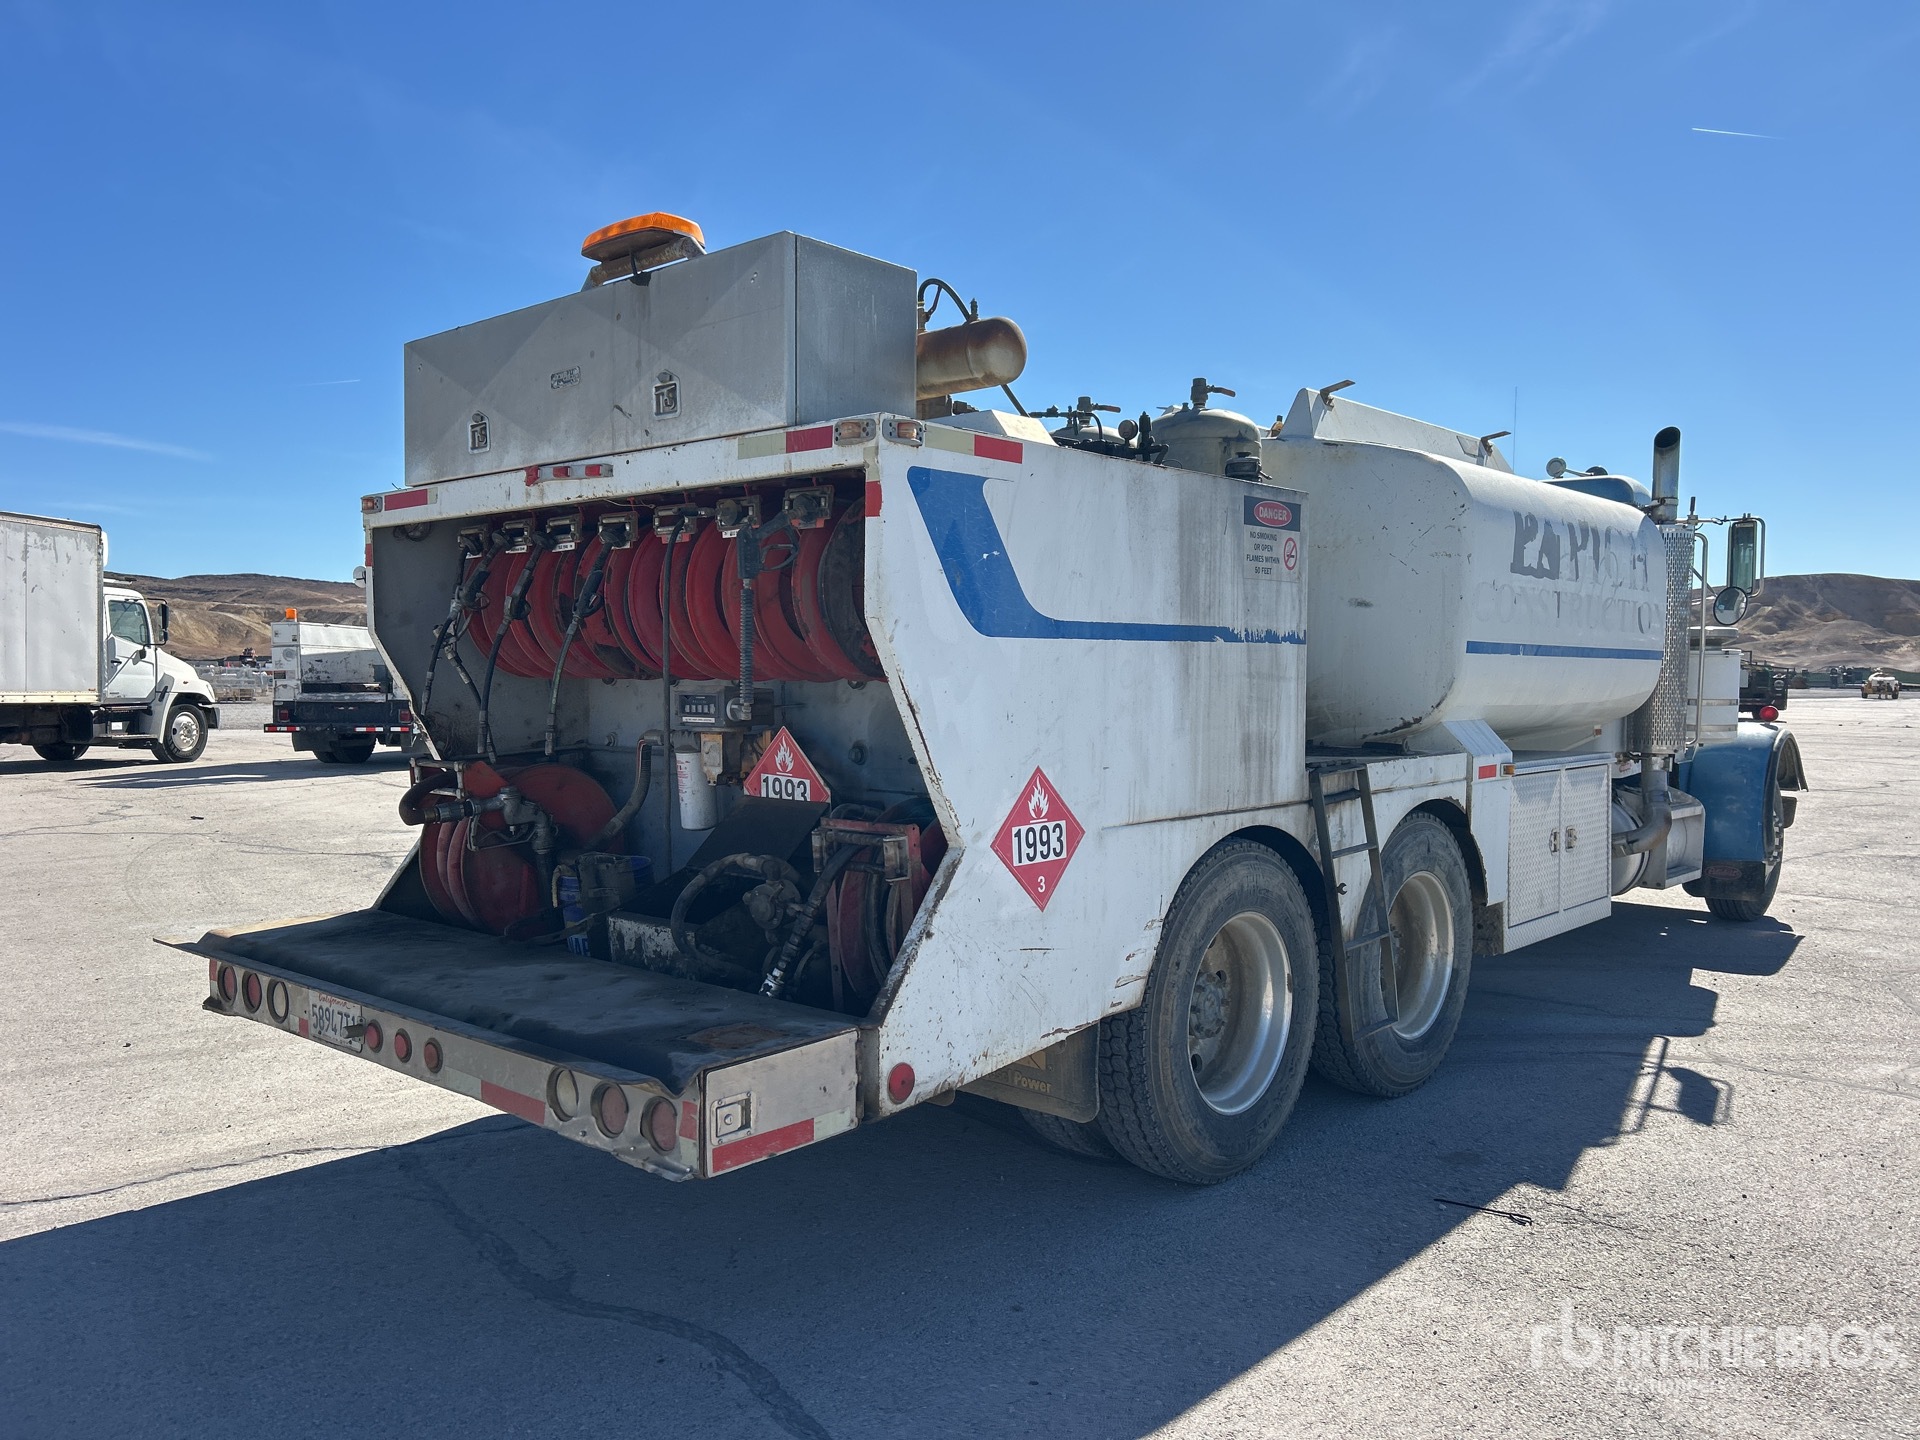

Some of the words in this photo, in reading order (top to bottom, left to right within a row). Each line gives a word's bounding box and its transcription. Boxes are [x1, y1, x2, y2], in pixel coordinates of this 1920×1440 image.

[1258, 506, 1288, 522] DANGER
[1249, 531, 1257, 539] NO
[1256, 531, 1278, 542] SMOKING
[1253, 542, 1261, 551] OR
[1261, 543, 1274, 552] OPEN
[1246, 554, 1264, 563] FLAMES
[1264, 555, 1280, 564] WITHIN
[1254, 566, 1261, 575] 50
[1261, 566, 1272, 575] FEET
[762, 775, 808, 801] 1993
[1013, 822, 1064, 864] 1993
[1037, 875, 1046, 893] 3
[318, 993, 351, 1009] California
[1014, 1070, 1053, 1094] Power
